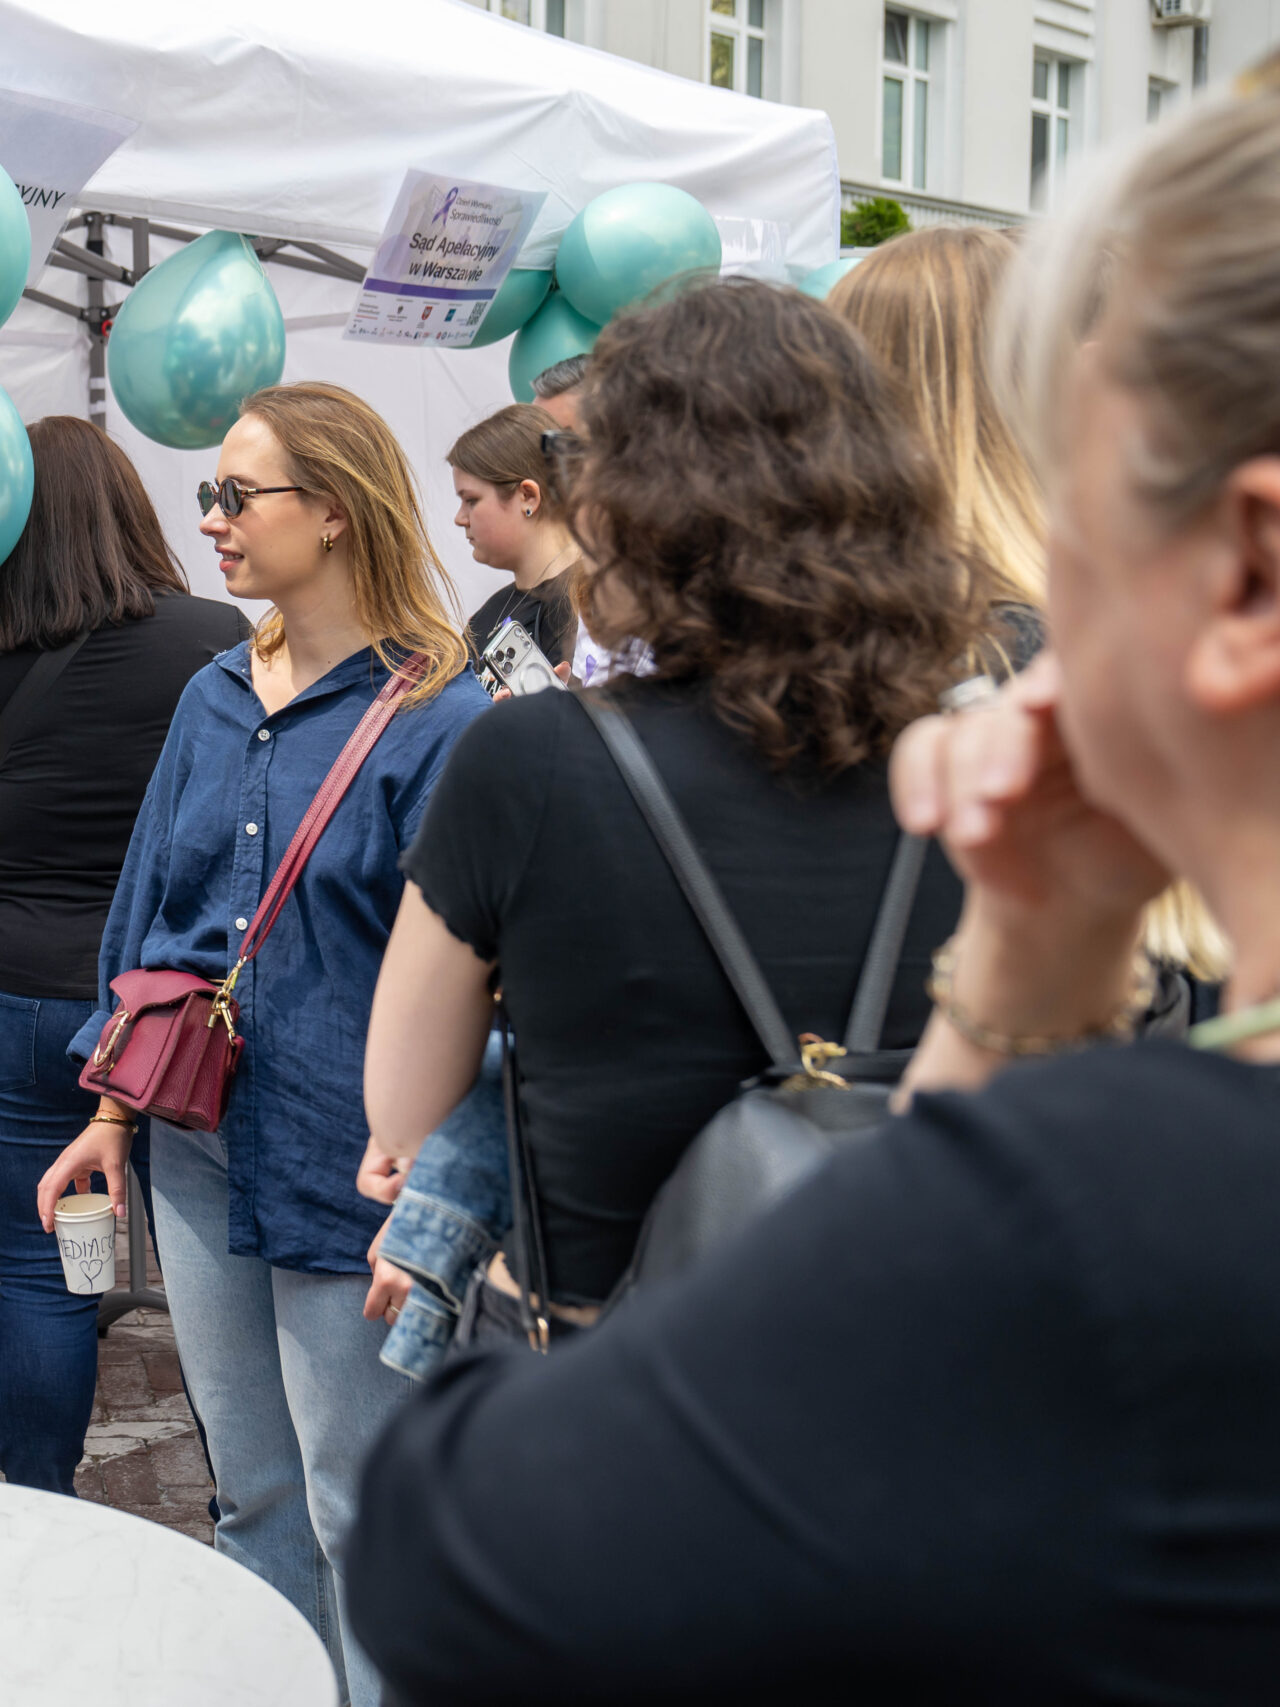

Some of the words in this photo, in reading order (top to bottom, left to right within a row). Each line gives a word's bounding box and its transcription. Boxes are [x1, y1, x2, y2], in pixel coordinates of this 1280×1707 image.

[15, 184, 66, 209] YJNY
[409, 232, 437, 254] Sąd
[436, 237, 499, 261] Apelacyjny
[409, 262, 422, 275] w
[423, 261, 482, 282] Warszawie
